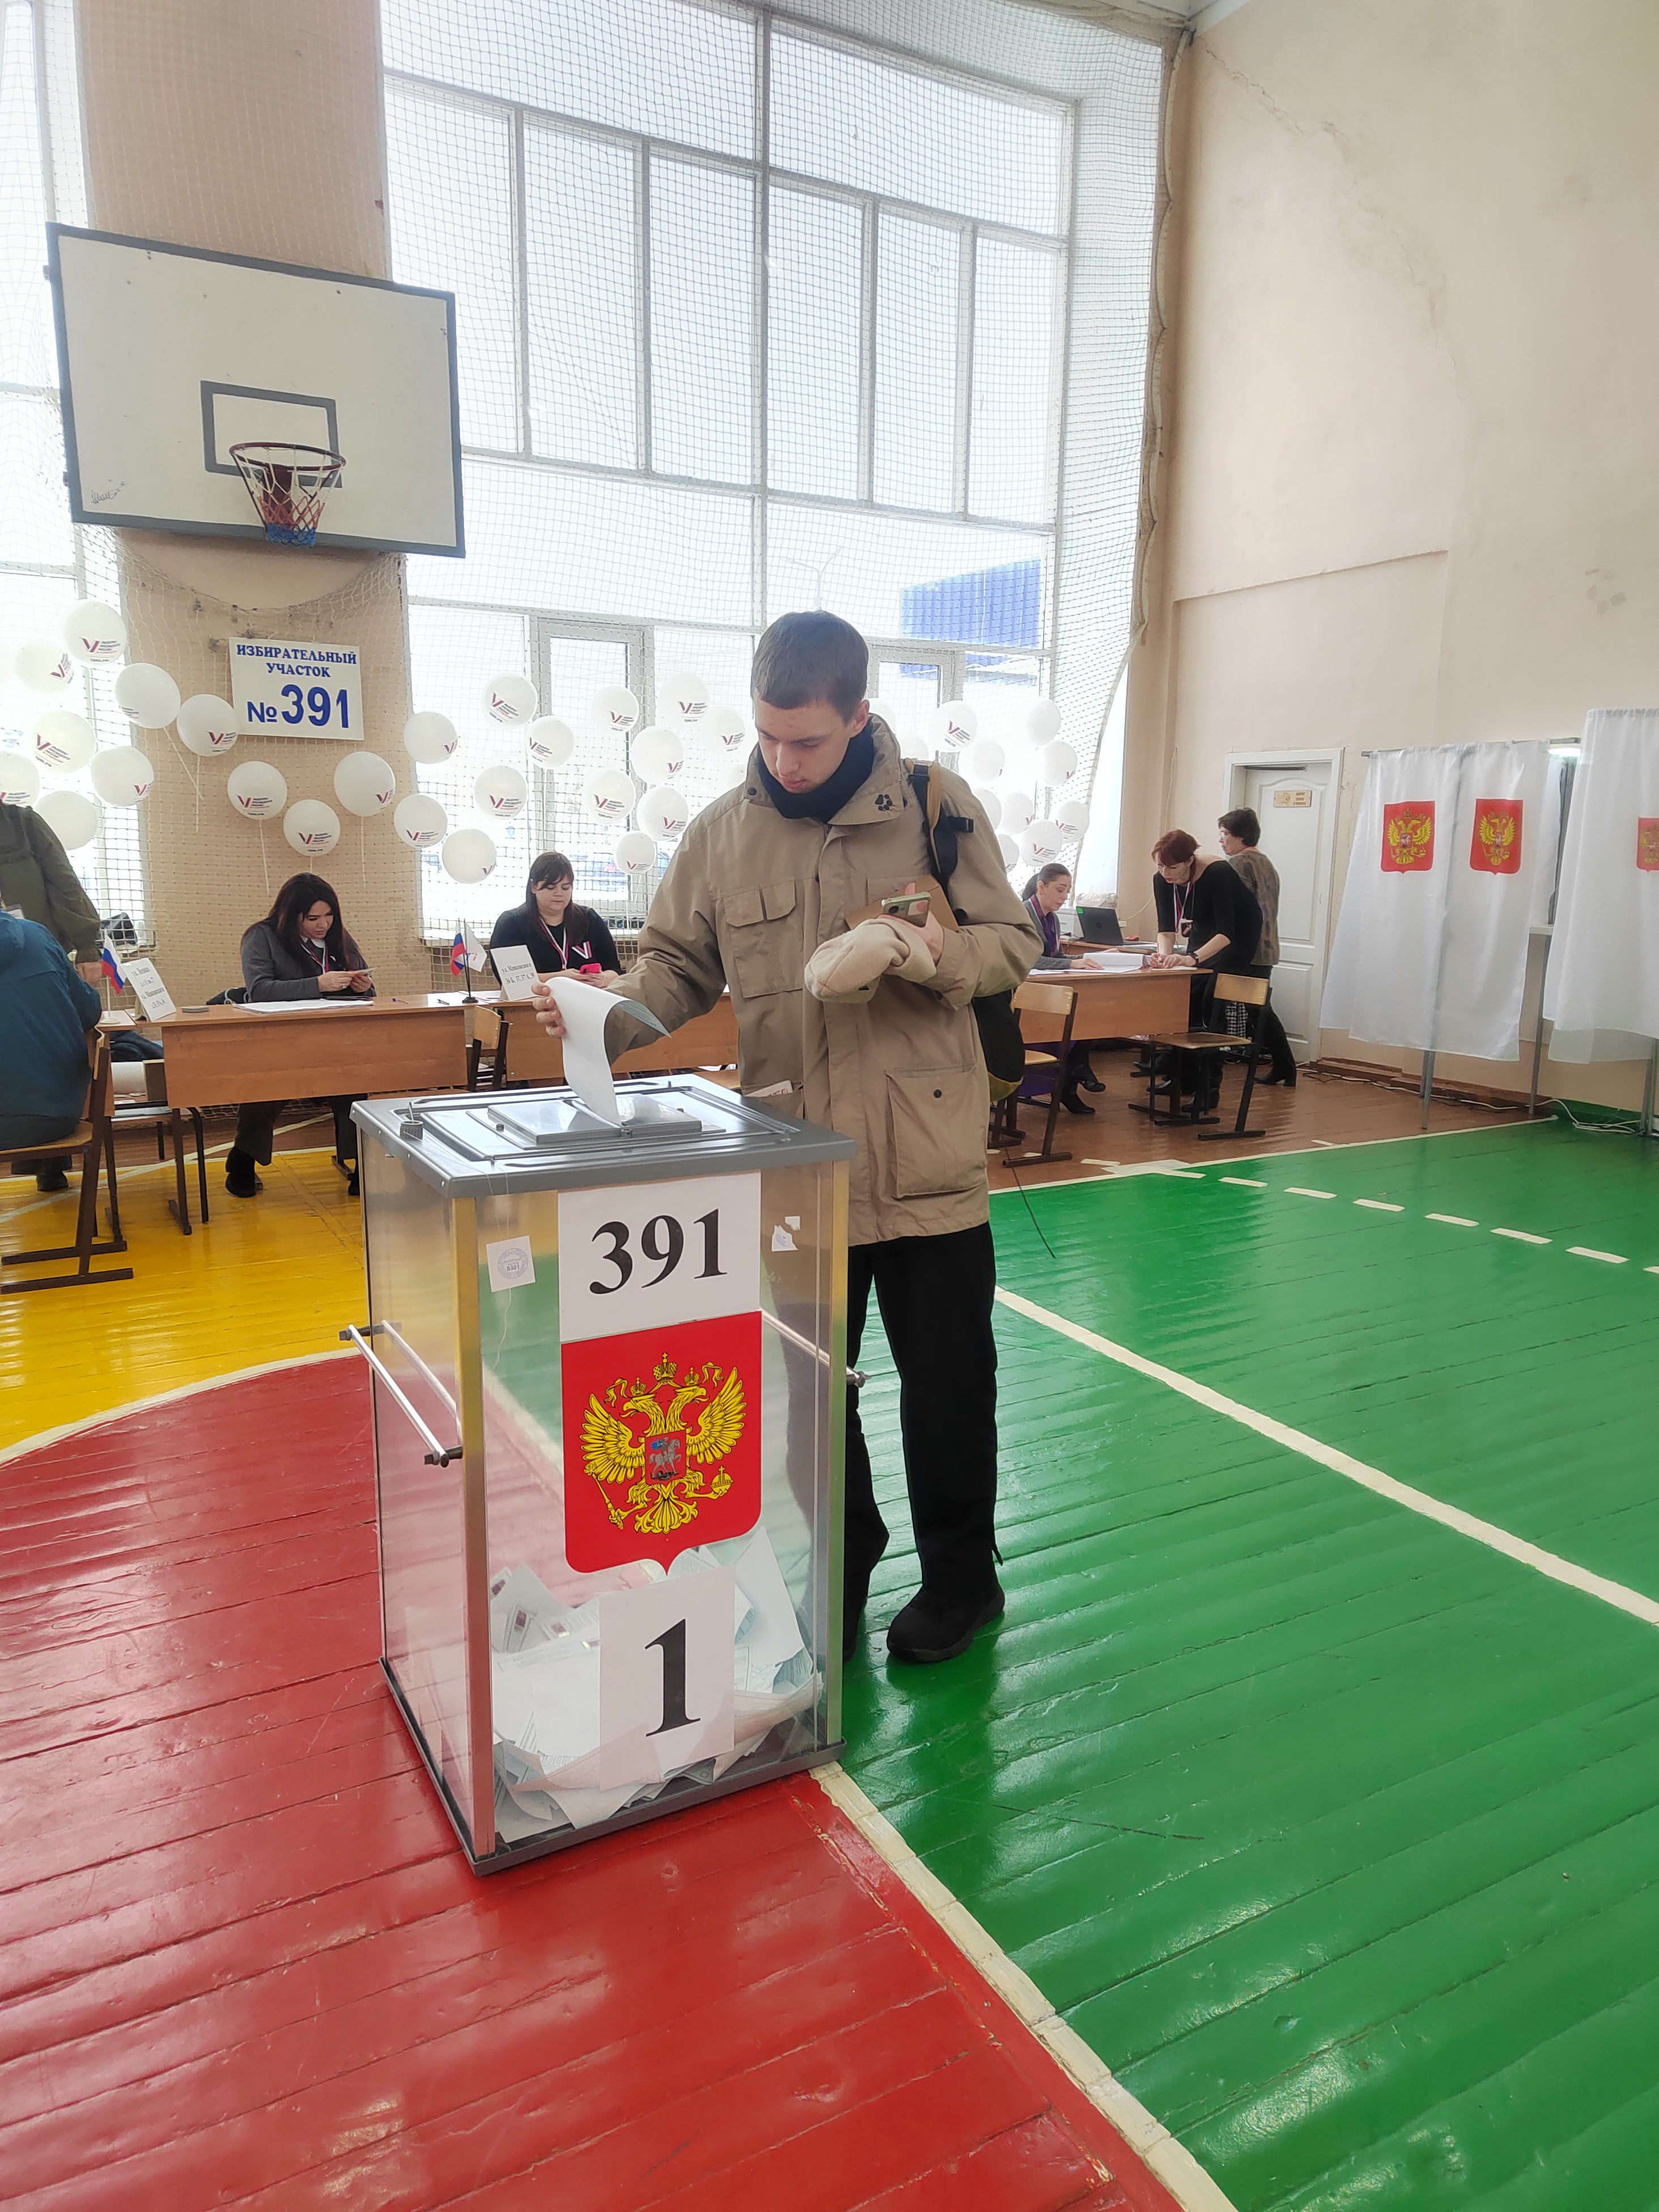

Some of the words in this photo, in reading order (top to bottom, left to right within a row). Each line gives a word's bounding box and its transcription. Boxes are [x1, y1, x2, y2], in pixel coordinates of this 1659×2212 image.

[236, 644, 357, 665] ИЗБИРАТЕЛЬНЫЙ
[266, 662, 331, 678] УЧАСТОК
[589, 1208, 728, 1295] 391
[644, 1618, 701, 1737] 1
